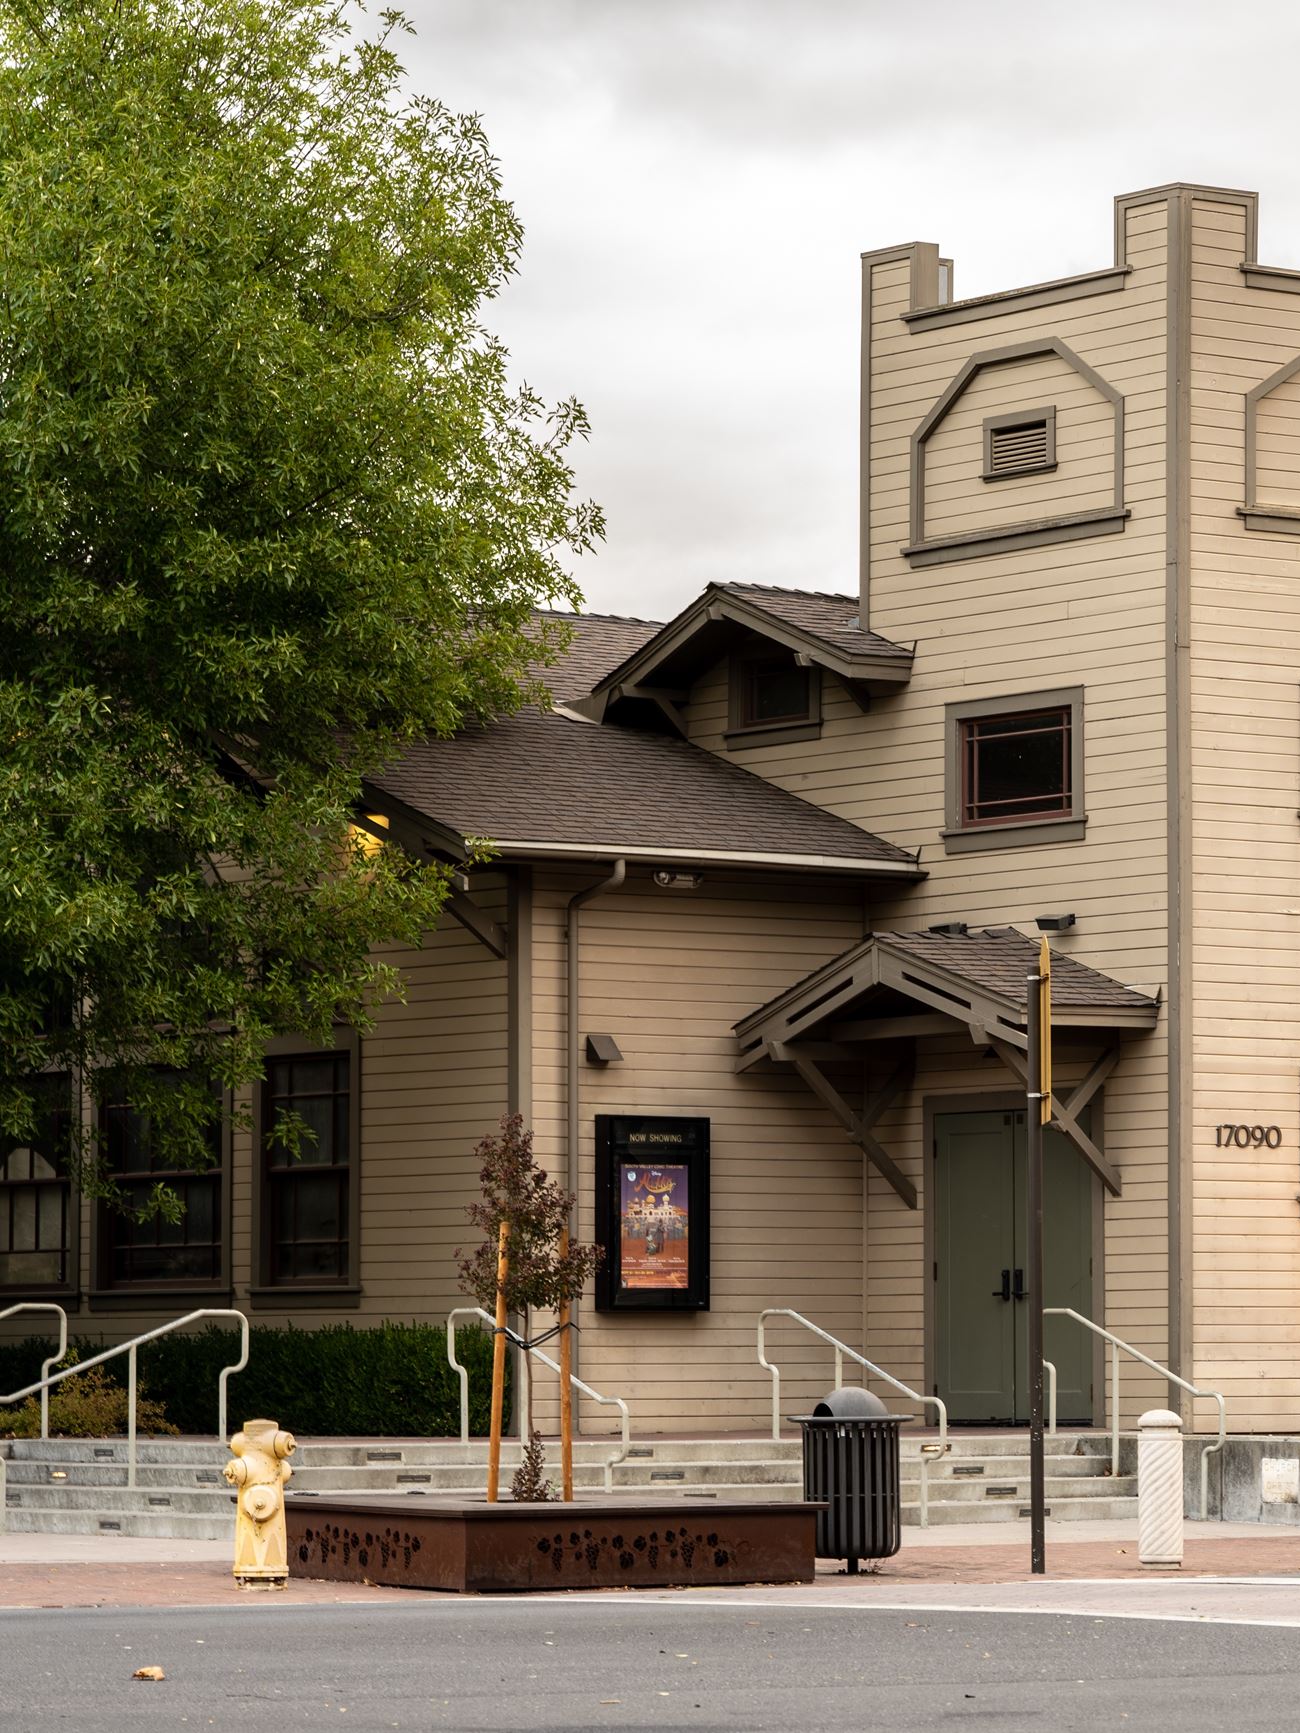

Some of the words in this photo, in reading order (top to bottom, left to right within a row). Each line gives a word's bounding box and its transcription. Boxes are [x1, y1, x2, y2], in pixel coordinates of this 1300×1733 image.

[629, 1133, 646, 1142] NOW
[649, 1133, 682, 1142] SHOWING
[1216, 1124, 1282, 1149] 17090
